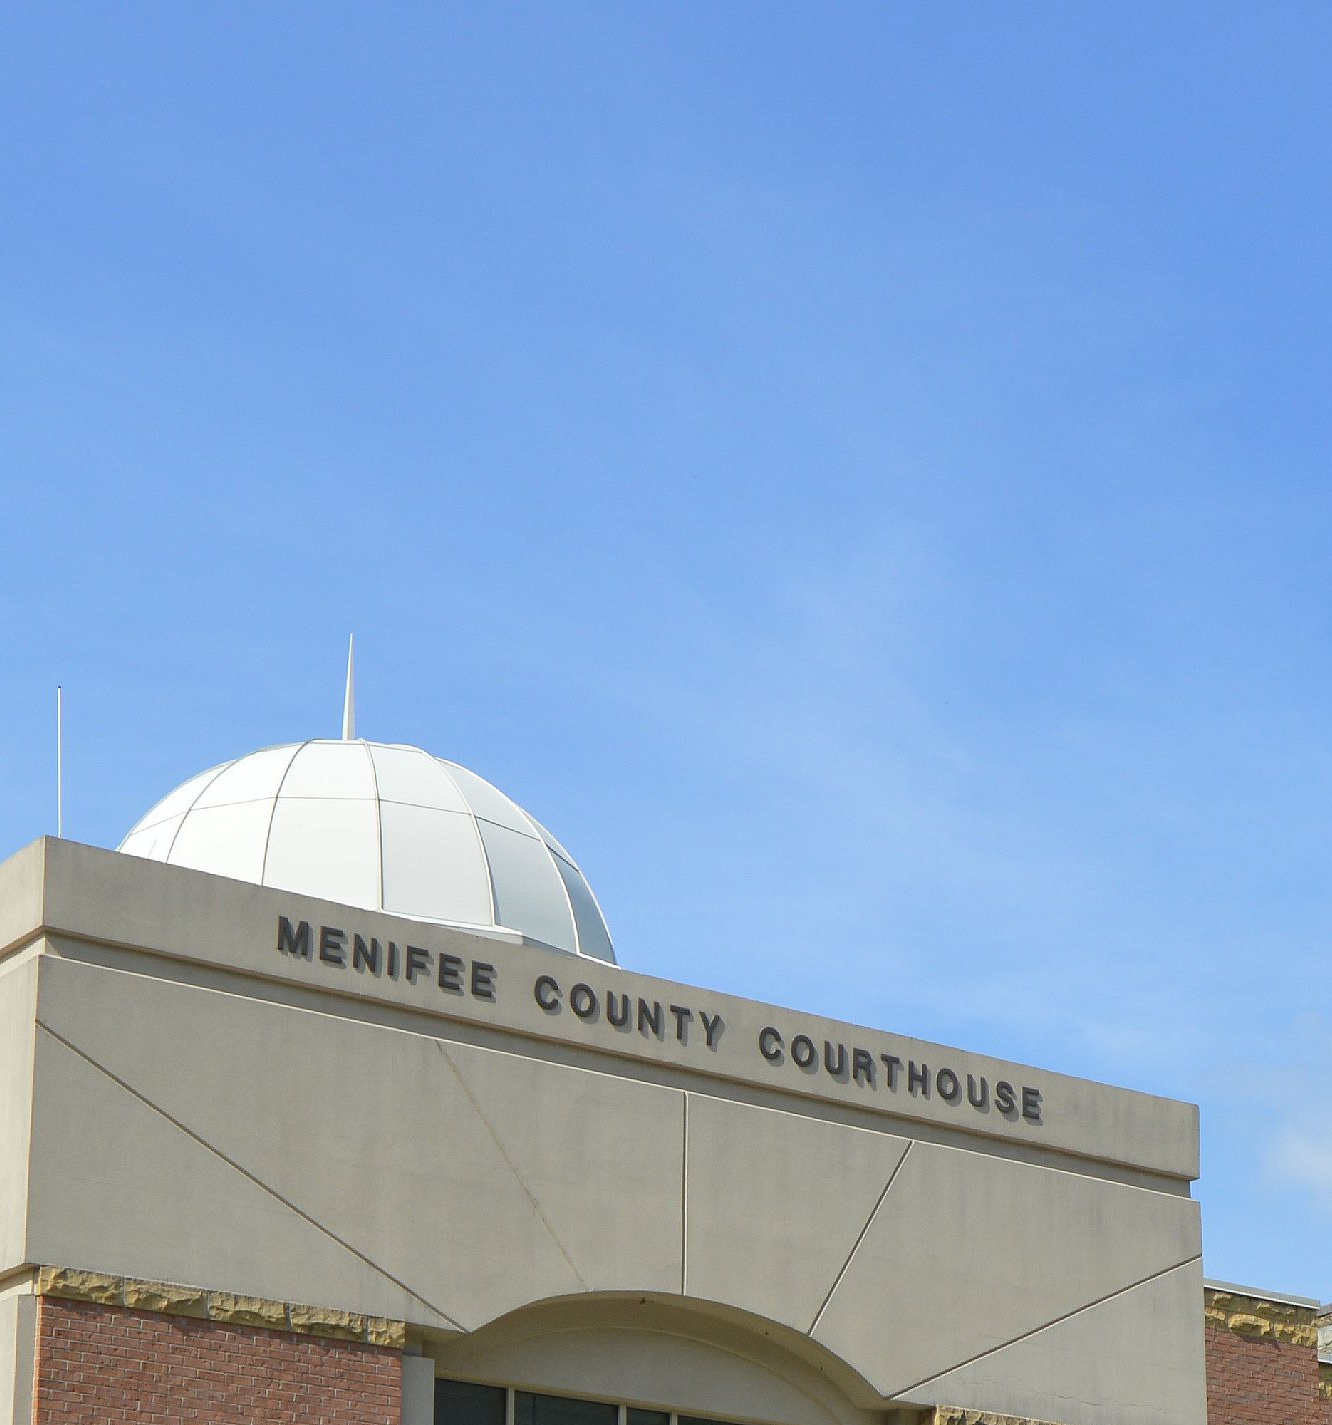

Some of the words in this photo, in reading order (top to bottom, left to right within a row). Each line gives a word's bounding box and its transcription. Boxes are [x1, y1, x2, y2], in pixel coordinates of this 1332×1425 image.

[277, 915, 496, 1001] MENIFEE
[533, 974, 723, 1048] COUNTY
[758, 1025, 1043, 1123] COURTHOUSE
